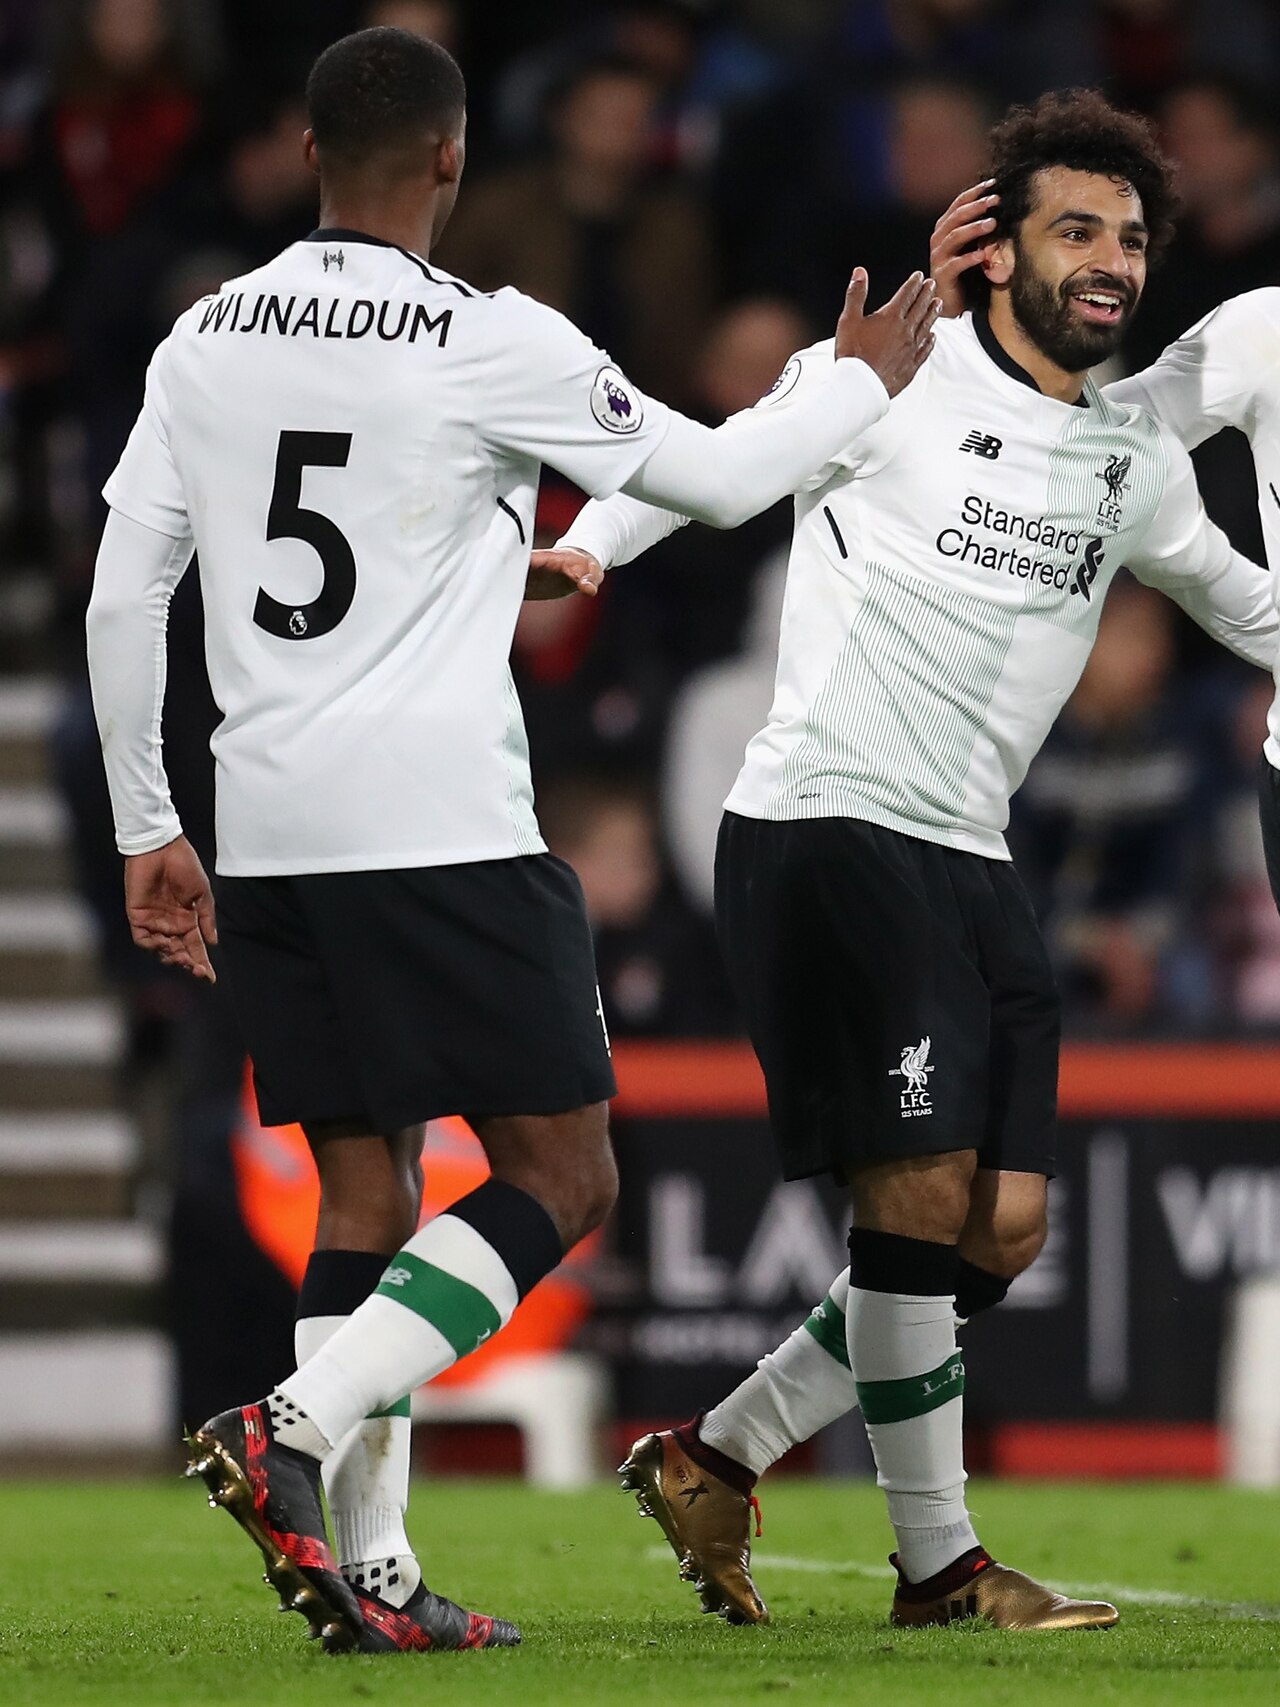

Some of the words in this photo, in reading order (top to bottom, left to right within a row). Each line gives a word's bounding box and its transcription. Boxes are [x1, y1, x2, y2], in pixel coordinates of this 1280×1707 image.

[198, 292, 453, 348] WIJNALDUM
[253, 430, 357, 640] 5
[961, 495, 1084, 556] Standard
[936, 528, 1072, 591] Chartered
